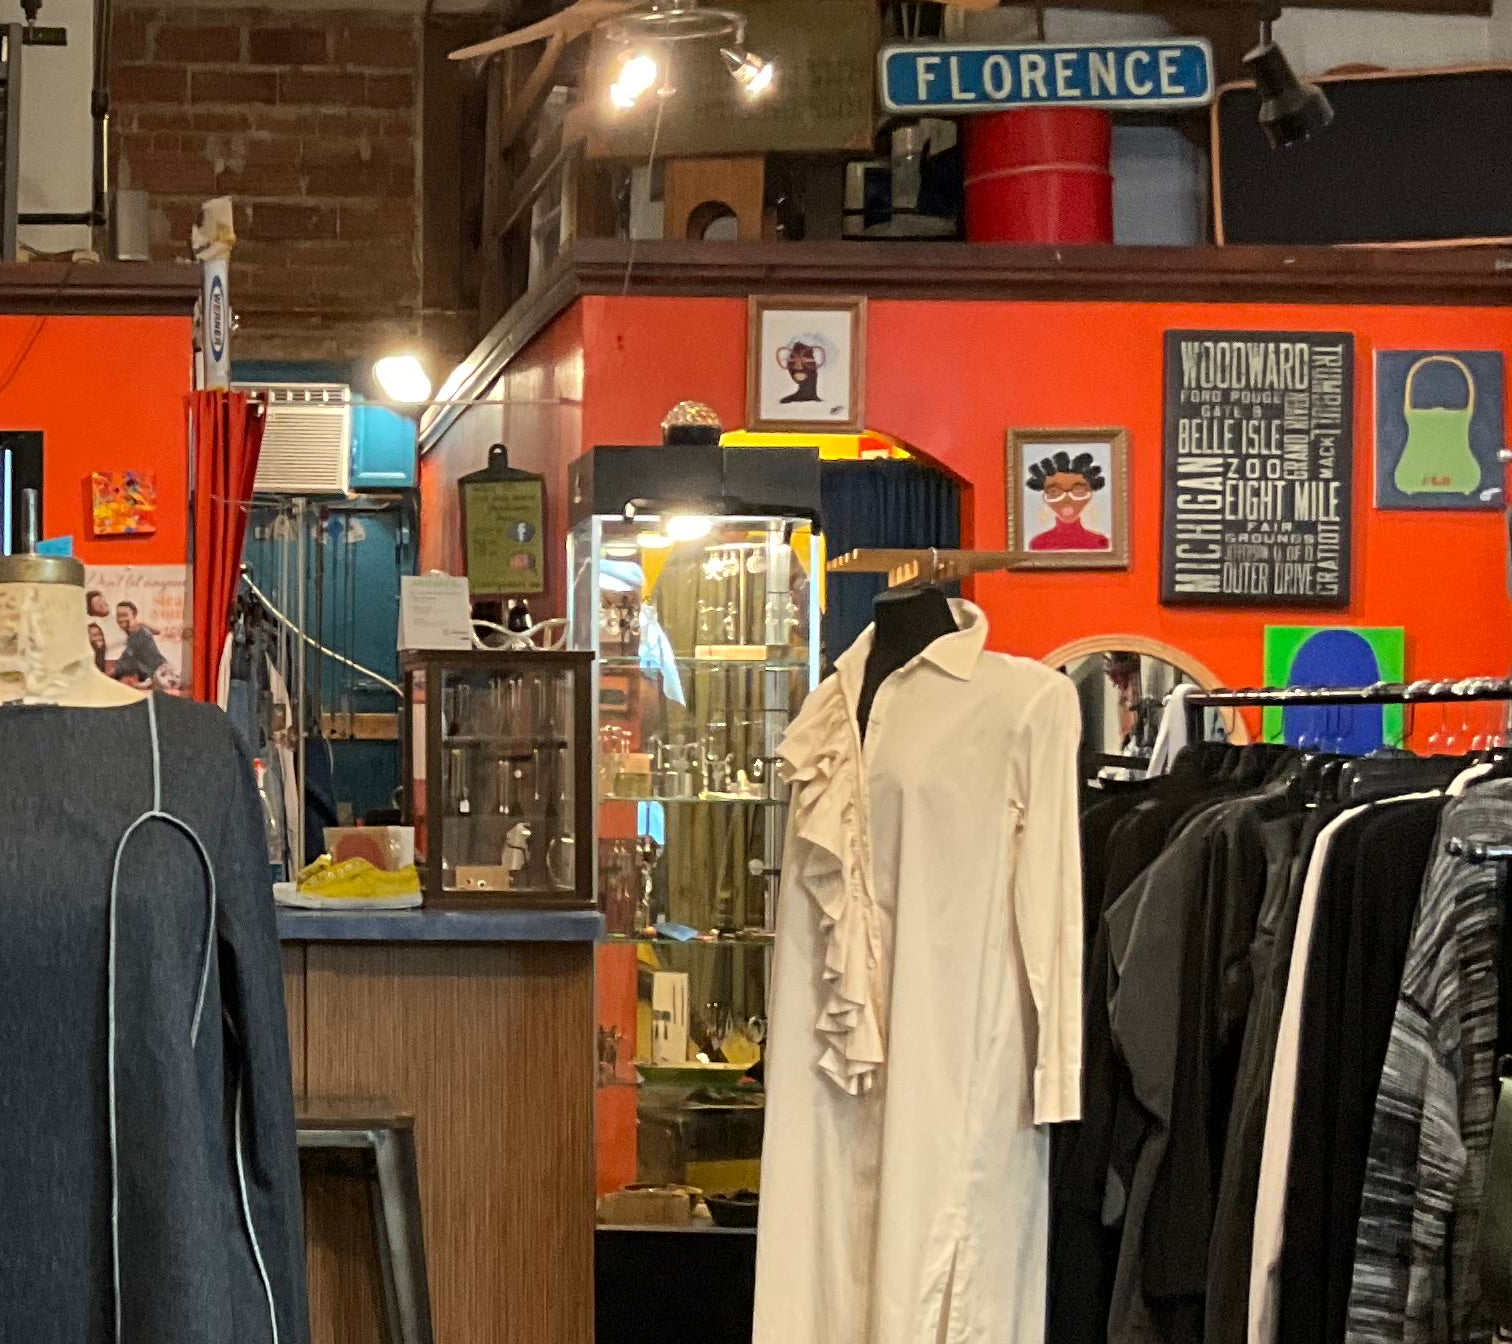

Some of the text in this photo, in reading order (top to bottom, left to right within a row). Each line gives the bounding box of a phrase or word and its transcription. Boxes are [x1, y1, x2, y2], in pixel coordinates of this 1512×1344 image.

[916, 49, 1186, 101] FLORENCE
[1180, 341, 1310, 389] WOODWARD
[1180, 389, 1222, 405] FORD
[1201, 405, 1242, 418] GATE
[1178, 418, 1282, 455] BELLE ISLE
[1226, 458, 1281, 479] ZOO
[1283, 434, 1309, 480] GRAND
[1317, 436, 1336, 479] MACK
[1224, 480, 1341, 522] EIGHT MILE
[1175, 457, 1224, 593] MICHIGAN
[1224, 532, 1315, 544] GROUNDS
[1246, 522, 1293, 532] FAIR
[1223, 561, 1317, 595] OUTER DRIVE
[1316, 522, 1341, 595] GRATIOT
